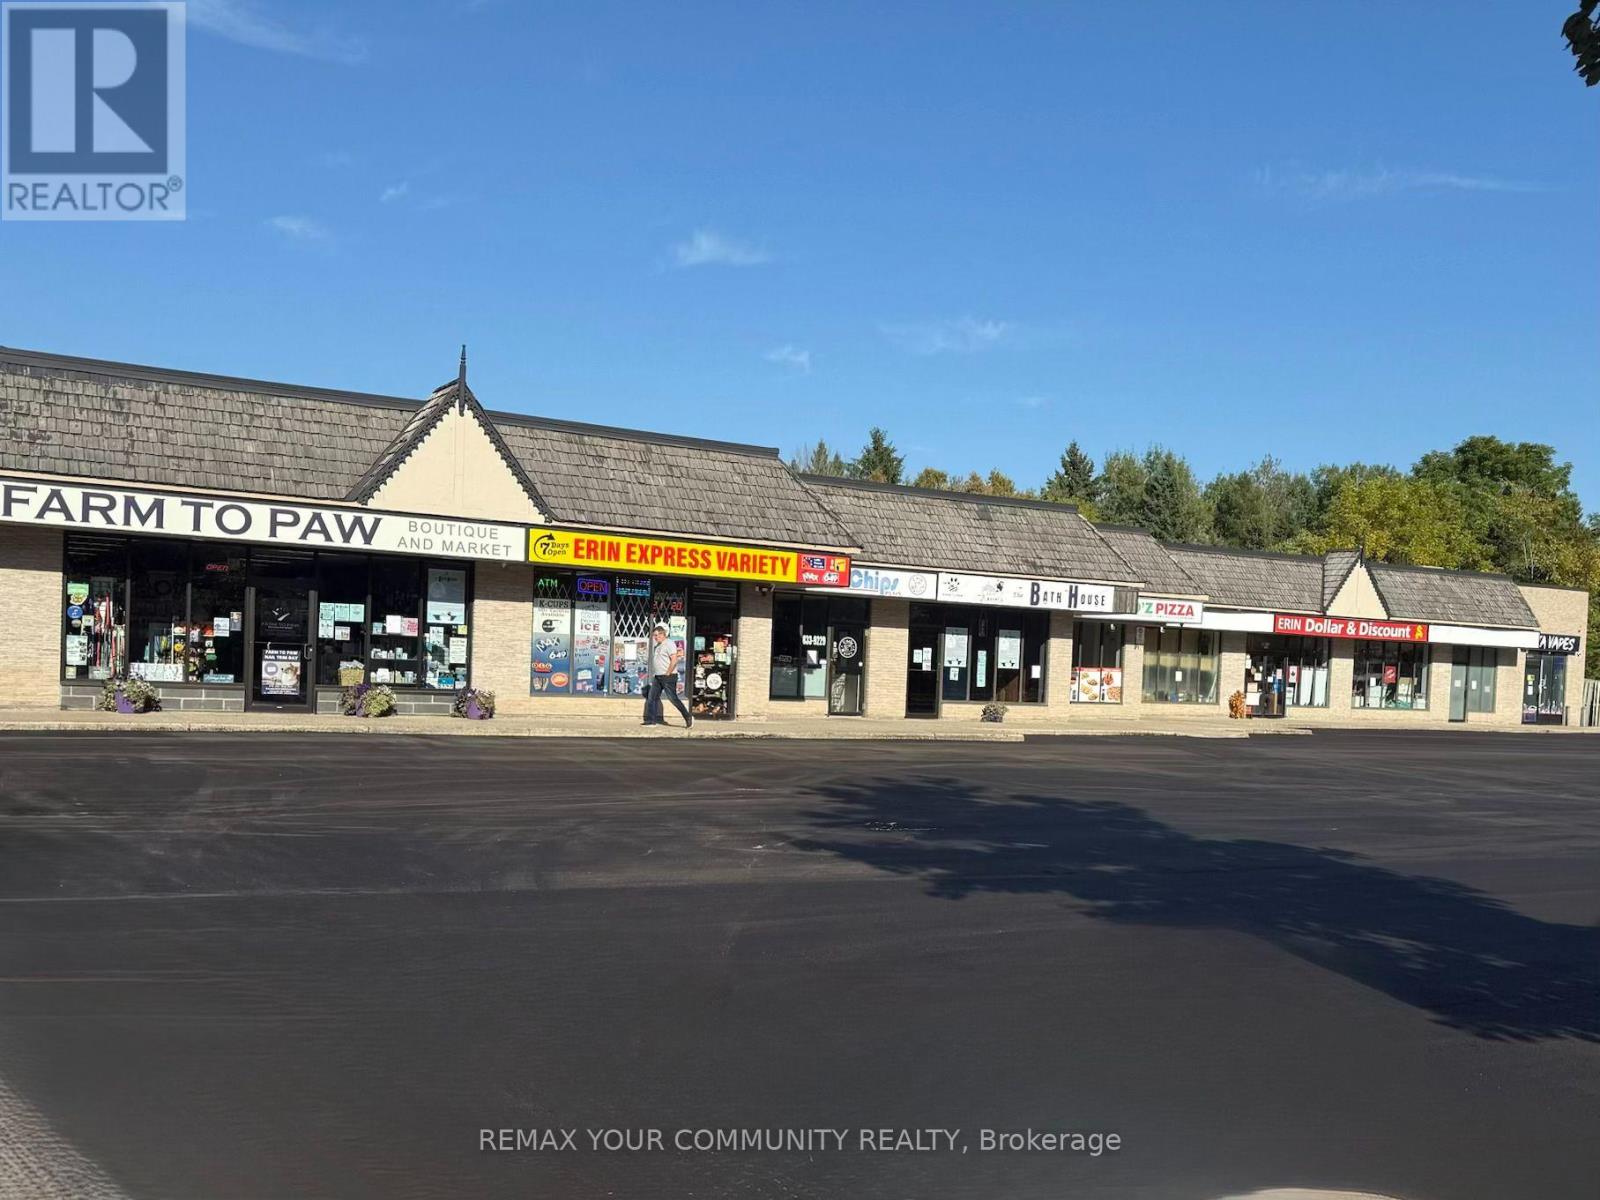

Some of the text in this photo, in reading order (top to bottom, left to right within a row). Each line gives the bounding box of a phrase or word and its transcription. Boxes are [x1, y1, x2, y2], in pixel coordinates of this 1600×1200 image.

[2, 484, 383, 545] FARM TO PAW
[408, 520, 499, 540] BOUTIQUE
[397, 536, 512, 557] AND MARKET
[540, 542, 570, 555] 7 Days
[548, 549, 567, 557] Open
[573, 538, 621, 562] ERIN
[626, 543, 712, 570] EXPRESS
[716, 551, 791, 576] VARIETY
[538, 579, 558, 588] ATM
[580, 581, 605, 592] OPEN
[851, 569, 899, 595] Chips
[539, 600, 569, 608] K-CUPS
[1156, 603, 1195, 617] PIZZA
[580, 623, 600, 631] ICE
[1278, 618, 1302, 631] ERIN
[1305, 618, 1344, 635] Dollar
[1346, 622, 1357, 635] &
[1359, 622, 1412, 639] Discount
[1548, 635, 1576, 652] VAPES
